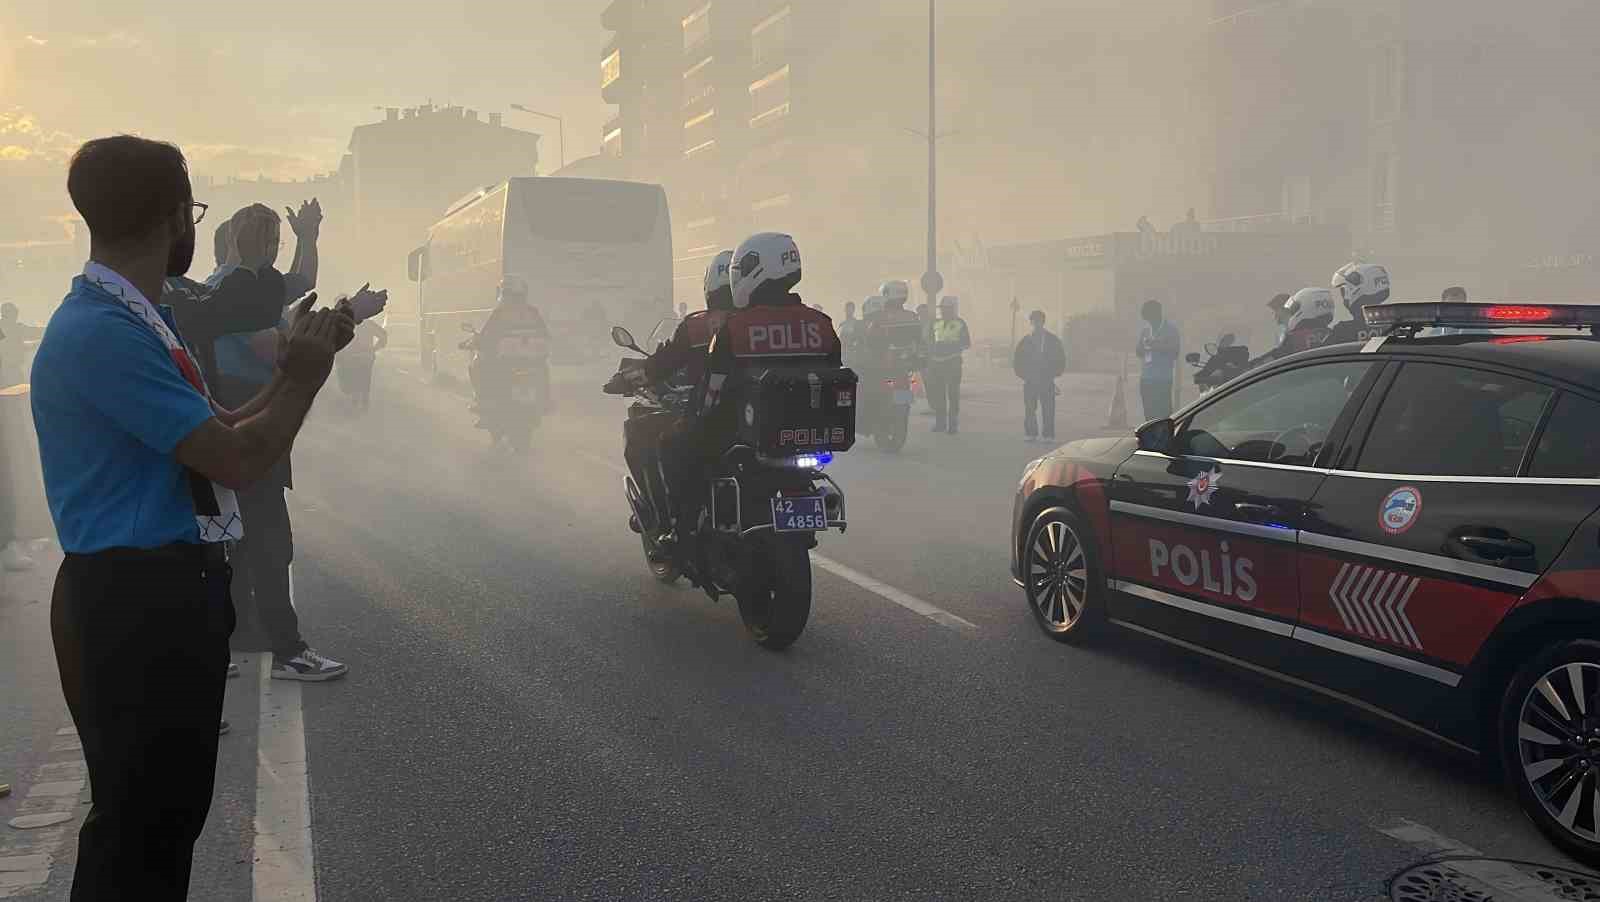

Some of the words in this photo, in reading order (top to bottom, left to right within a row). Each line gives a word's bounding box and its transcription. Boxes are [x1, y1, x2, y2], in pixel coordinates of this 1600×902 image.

[775, 501, 794, 513] 42
[814, 501, 823, 513] A
[787, 515, 824, 528] 4856
[1149, 540, 1257, 601] POLİS
